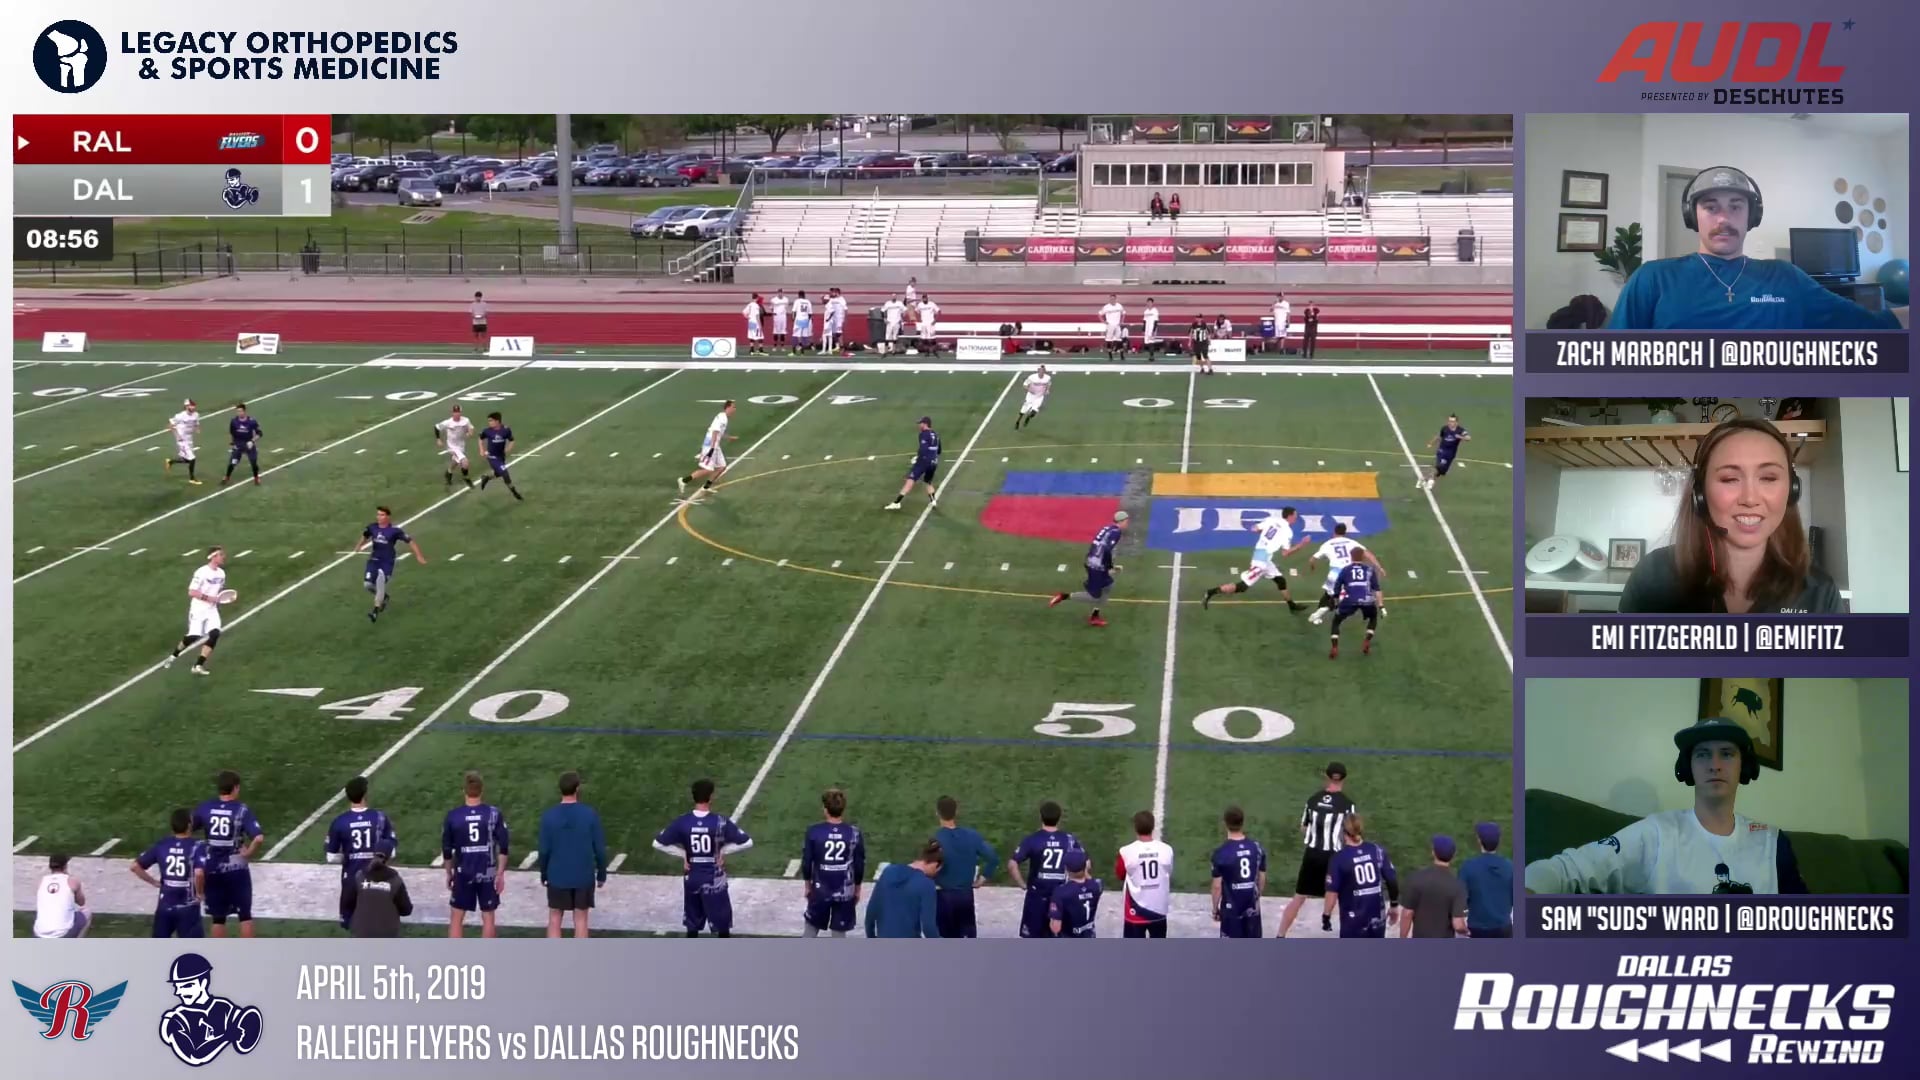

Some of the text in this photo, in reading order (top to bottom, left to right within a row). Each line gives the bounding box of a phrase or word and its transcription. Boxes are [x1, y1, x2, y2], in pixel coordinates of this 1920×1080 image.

[1028, 244, 1076, 255] CARDINALS
[1126, 244, 1175, 255] CARDINALS
[1226, 244, 1275, 256] CARDINALS
[1328, 244, 1377, 256] CARDINALS
[1351, 569, 1364, 580] 13
[209, 816, 230, 836] 26
[468, 822, 480, 842] 5
[351, 828, 372, 849] 31
[690, 834, 712, 854] 50
[824, 840, 846, 861] 22
[1042, 848, 1064, 869] 27
[166, 855, 186, 877] 25
[1139, 860, 1159, 880] 10
[1239, 857, 1251, 878] 8
[1354, 862, 1377, 885] 00
[1082, 900, 1091, 921] 1
